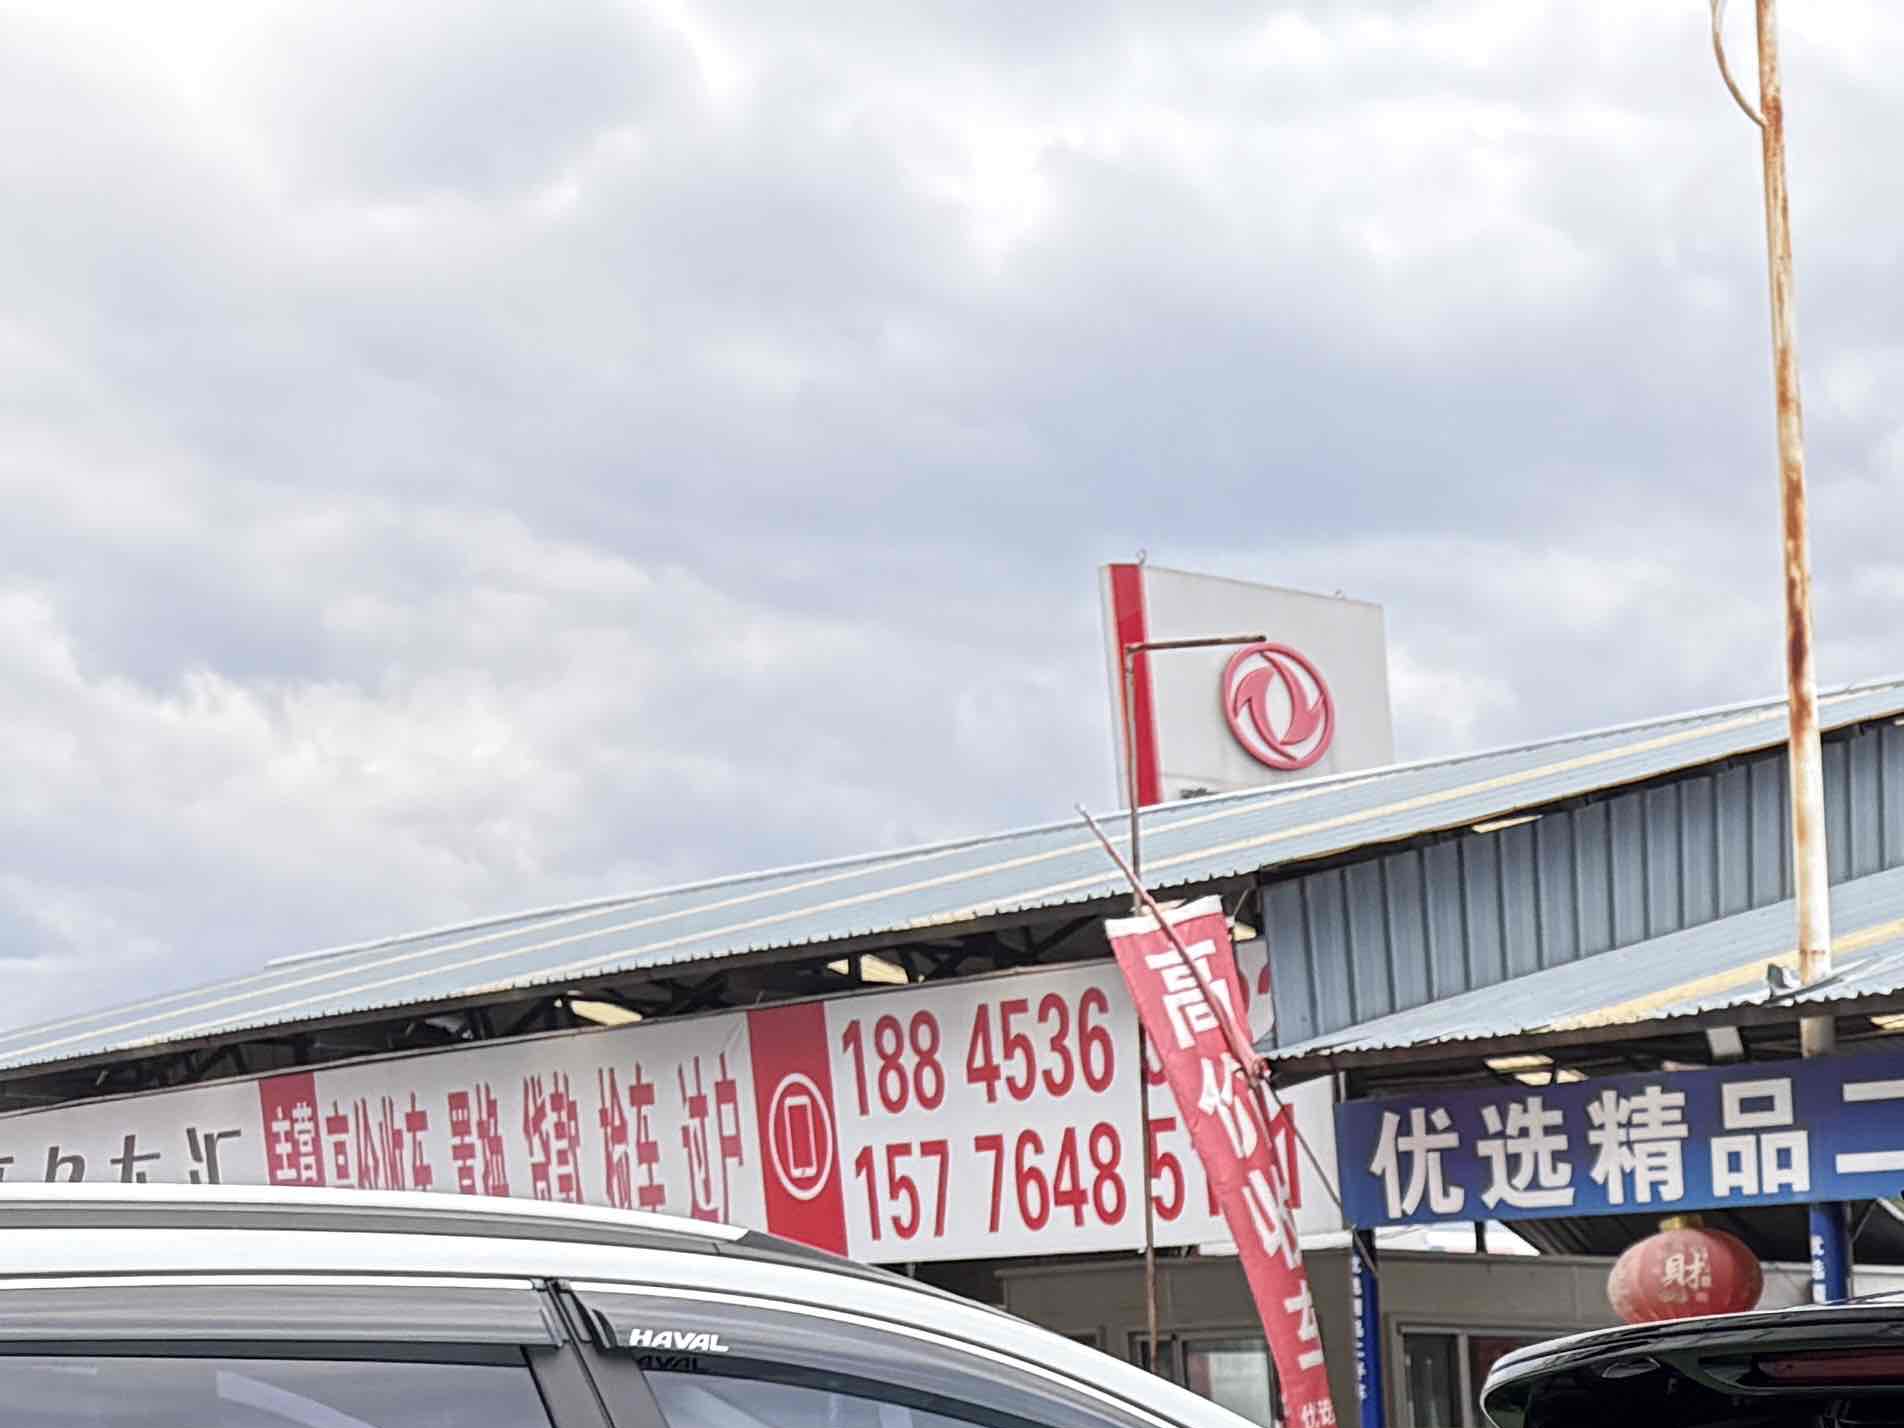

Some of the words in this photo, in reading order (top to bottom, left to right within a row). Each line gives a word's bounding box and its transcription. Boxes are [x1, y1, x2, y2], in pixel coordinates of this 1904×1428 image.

[842, 1010, 945, 1116] 188
[966, 987, 1115, 1103] 4536
[855, 1139, 950, 1241] 157
[974, 1121, 1127, 1233] 7648
[629, 1328, 729, 1353] HAVAL
